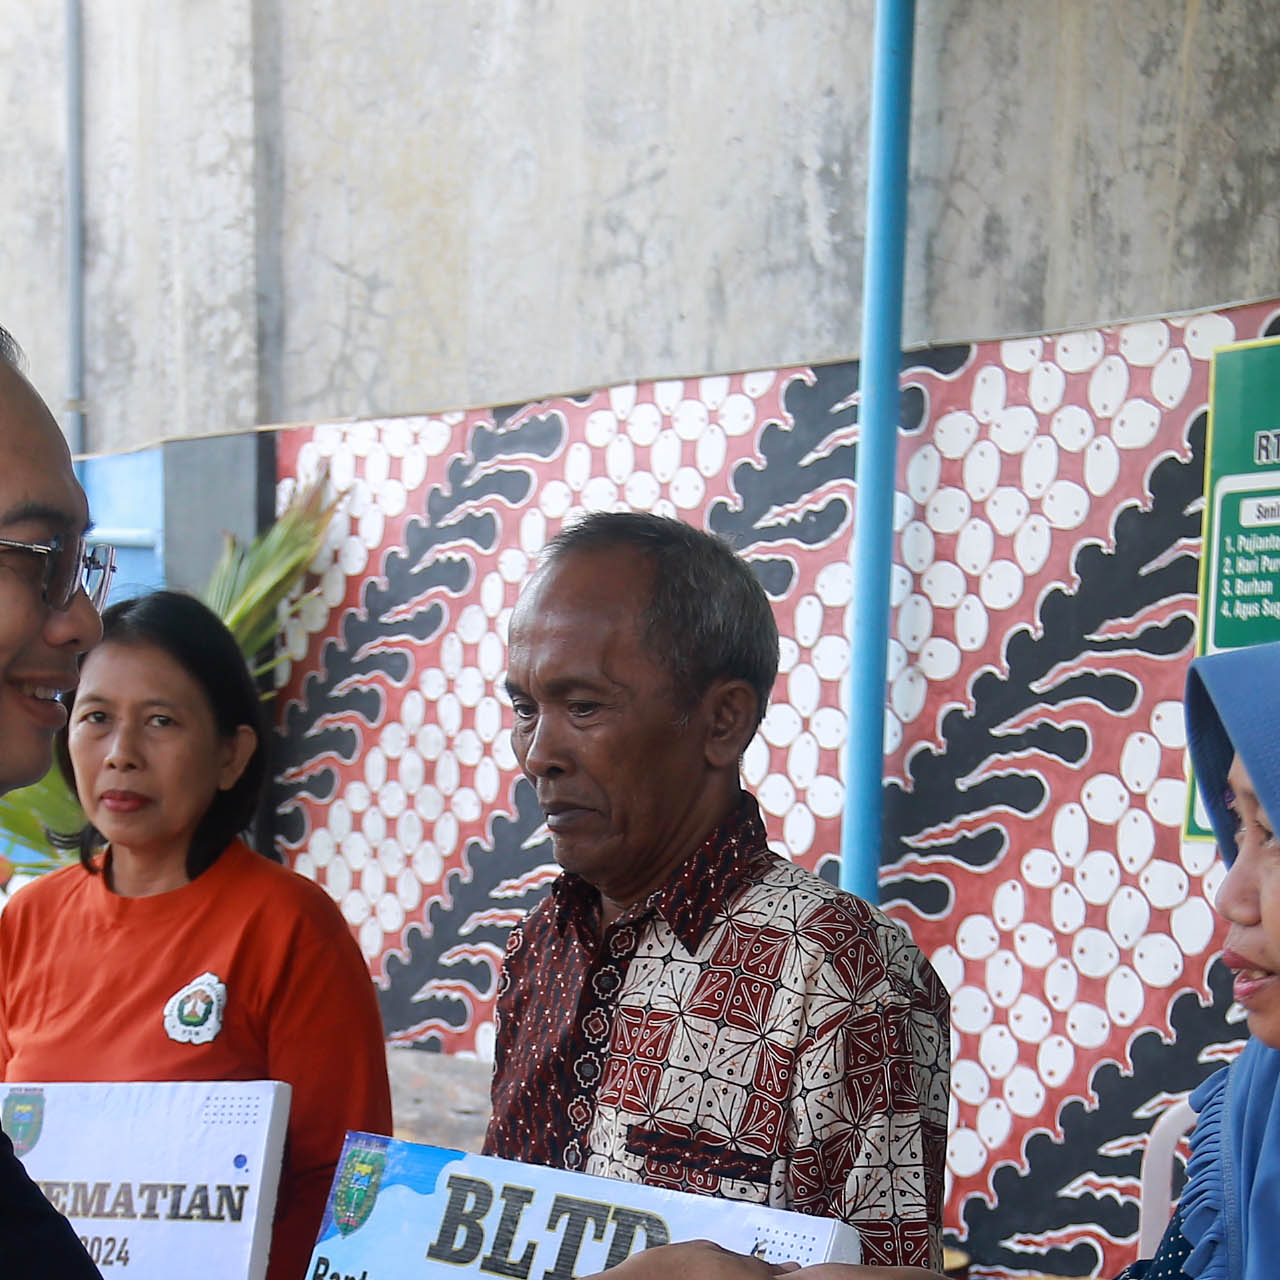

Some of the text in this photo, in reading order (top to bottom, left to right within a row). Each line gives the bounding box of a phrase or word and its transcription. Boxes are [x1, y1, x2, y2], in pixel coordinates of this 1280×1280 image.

[1224, 537, 1236, 553] 1.
[1222, 559, 1234, 576] 2.
[1222, 580, 1233, 597] 3.
[1220, 602, 1232, 618] 4.
